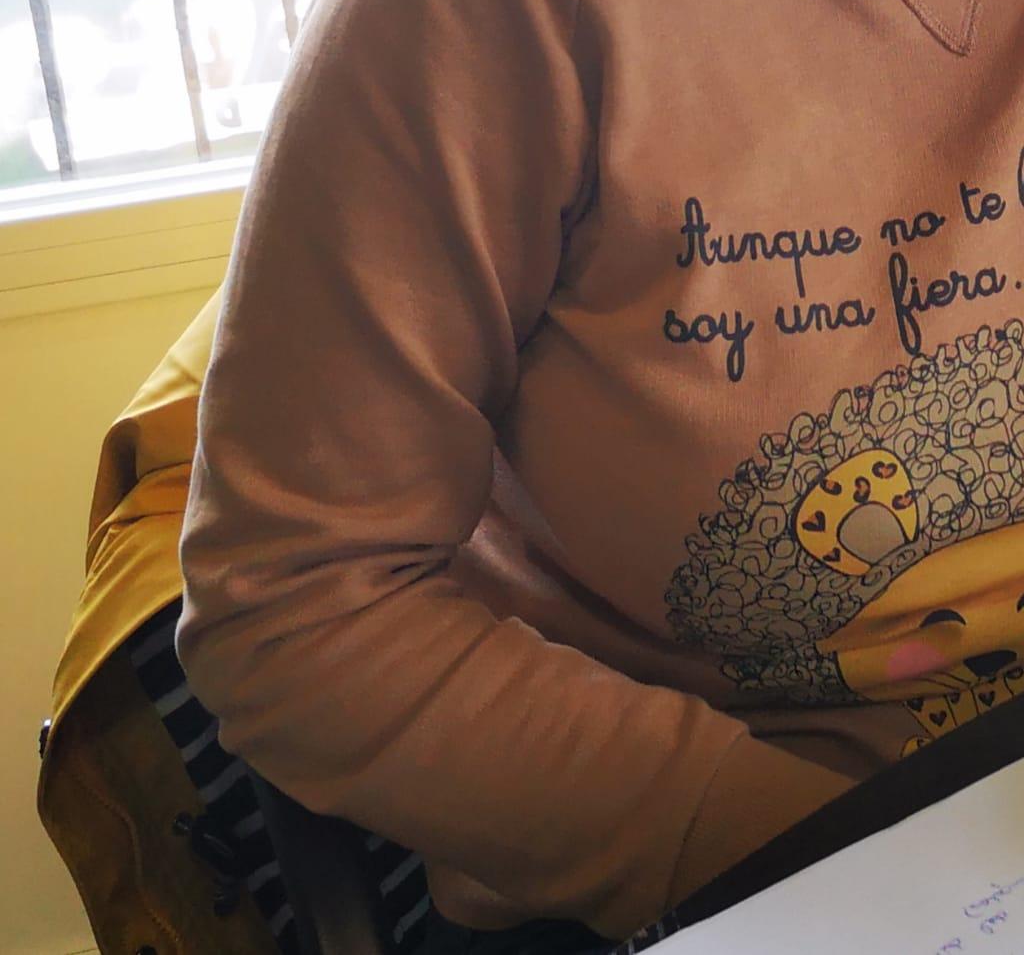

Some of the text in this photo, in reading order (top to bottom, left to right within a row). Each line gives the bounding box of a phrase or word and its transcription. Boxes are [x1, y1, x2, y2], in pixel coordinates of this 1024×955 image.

[676, 197, 862, 298] Aunque
[880, 211, 945, 247] no
[959, 181, 1006, 224] te
[664, 309, 754, 382] soy
[775, 299, 876, 334] una
